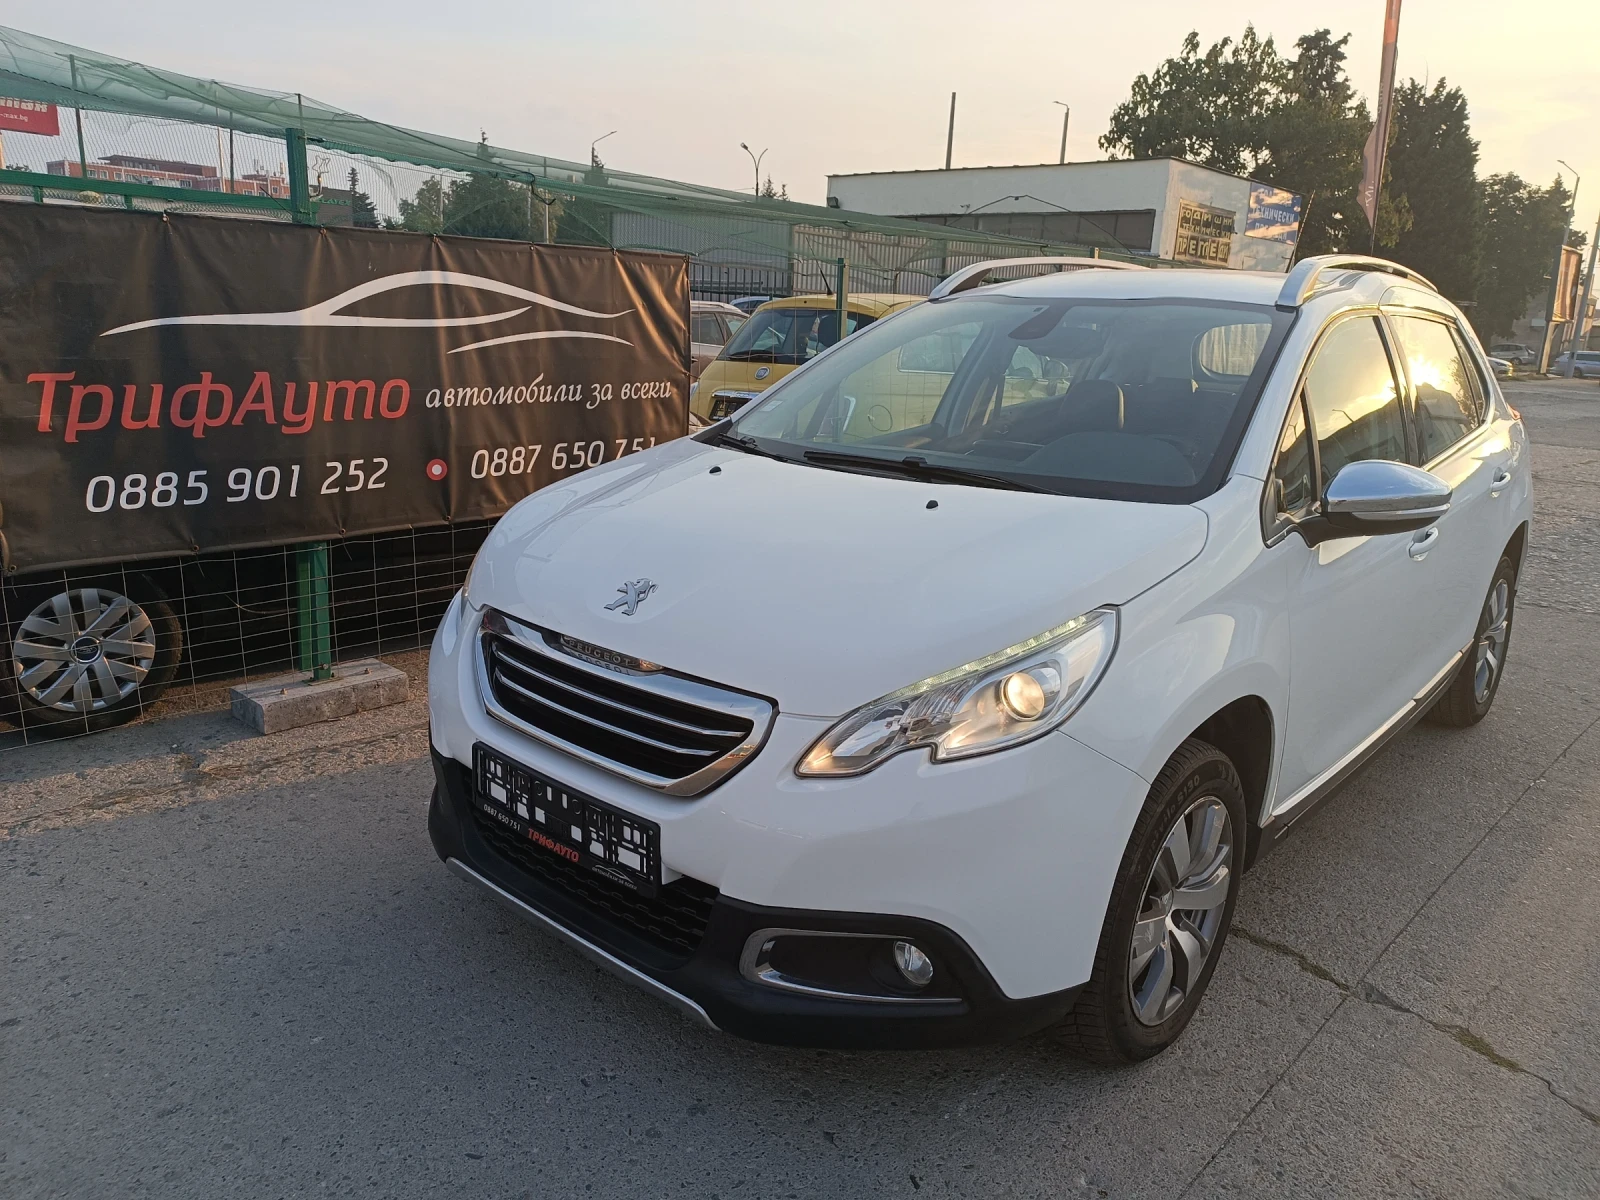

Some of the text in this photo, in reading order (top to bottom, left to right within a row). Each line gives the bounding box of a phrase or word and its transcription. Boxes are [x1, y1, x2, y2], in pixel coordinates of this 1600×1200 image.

[27, 371, 673, 443] ТрифАуто автомобили за всеки
[470, 444, 543, 479] 0887
[551, 440, 605, 470] 650
[86, 457, 389, 513] 0885 901 252
[569, 640, 631, 666] PEUGEOT
[528, 828, 579, 862] ТРИФАУТО
